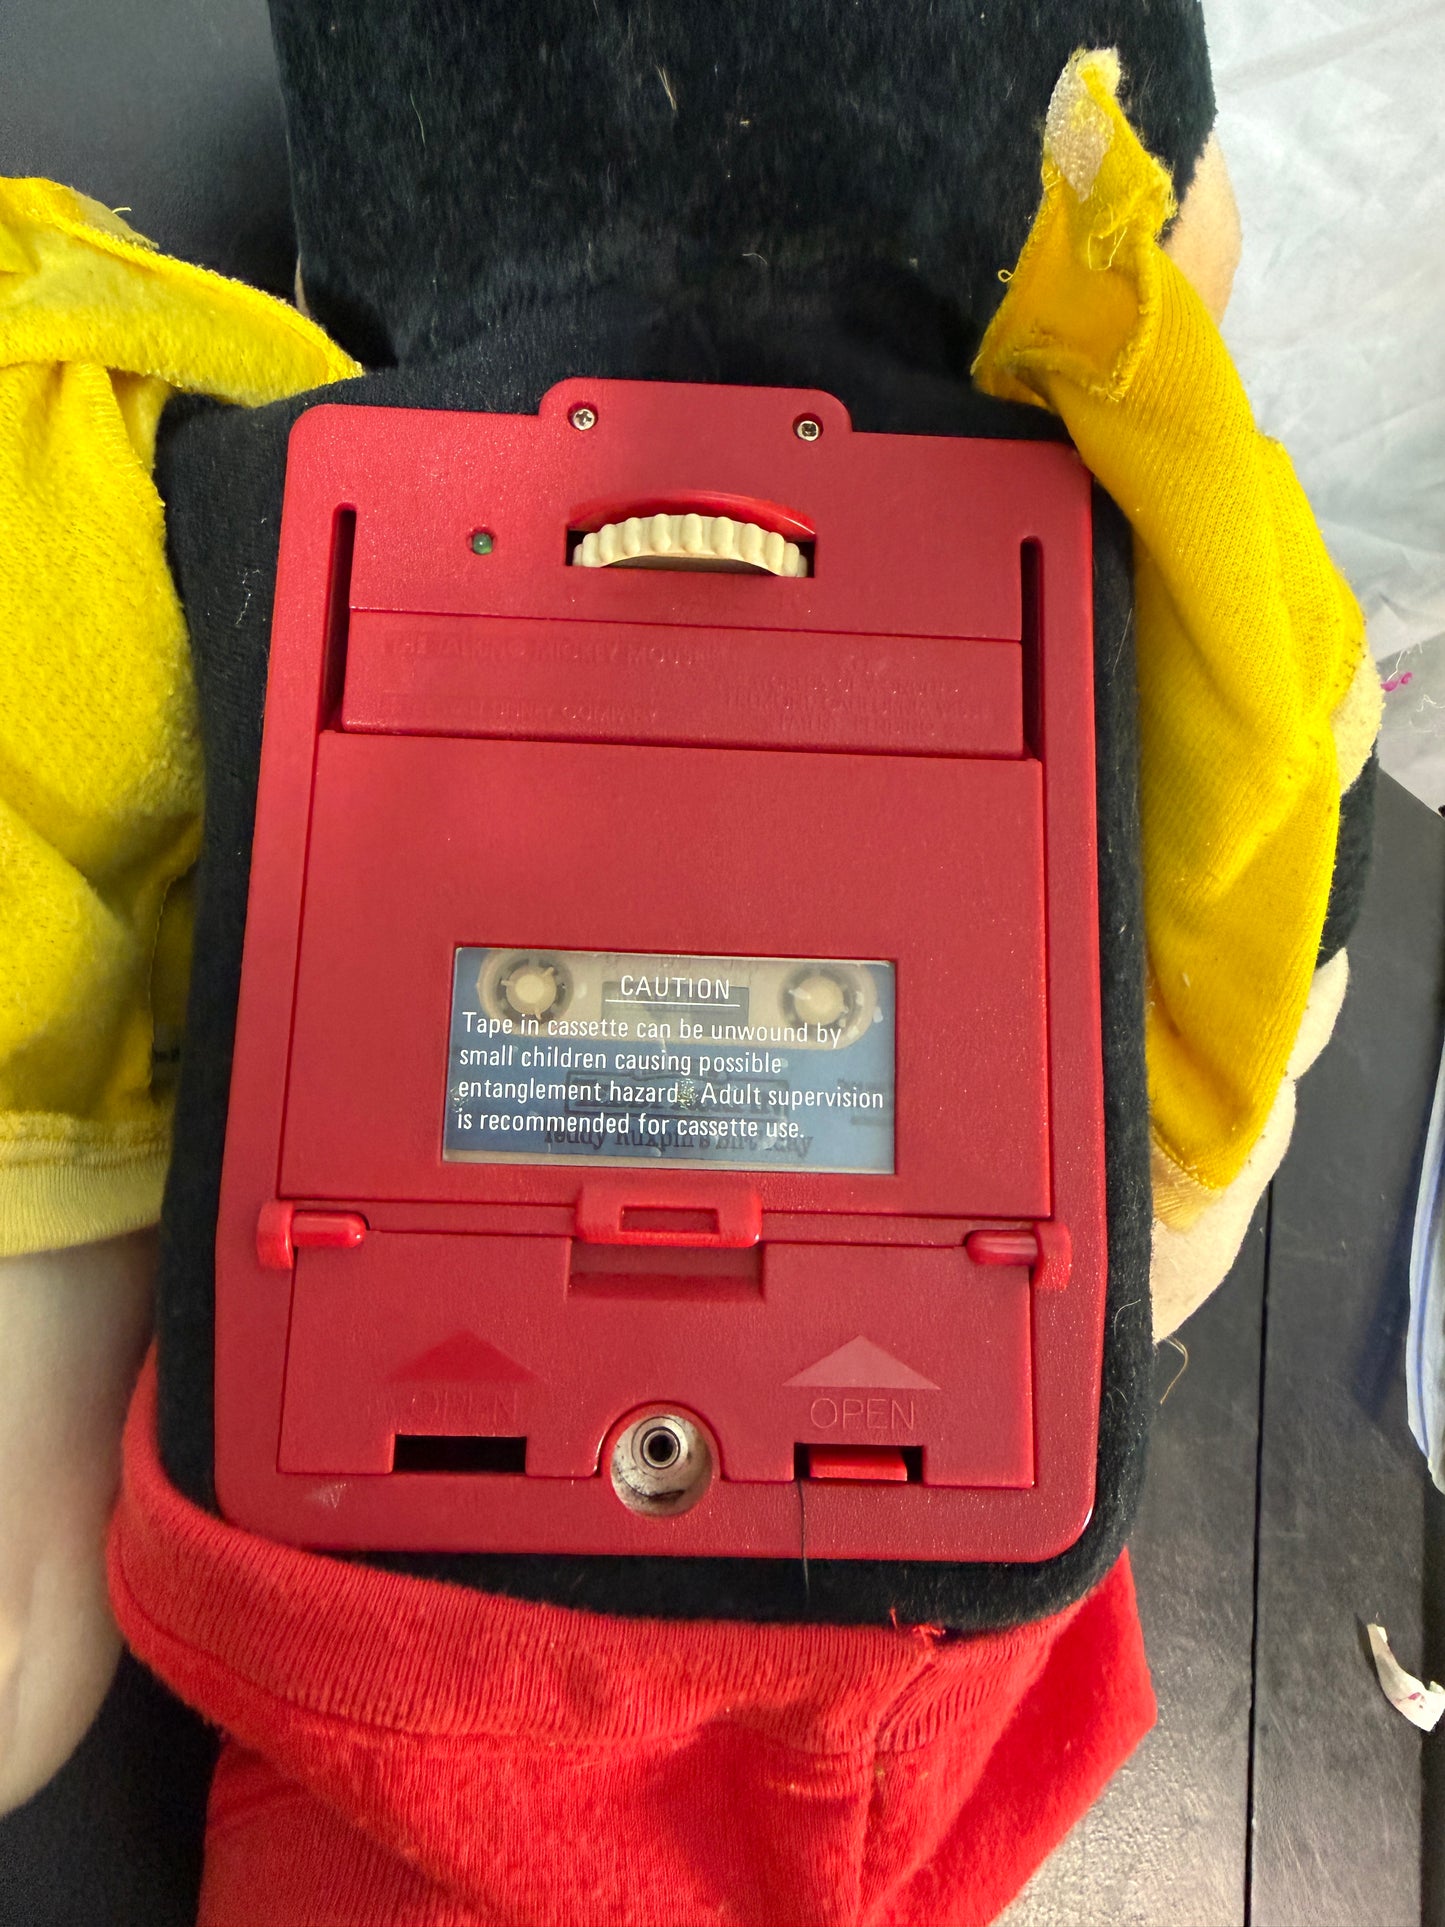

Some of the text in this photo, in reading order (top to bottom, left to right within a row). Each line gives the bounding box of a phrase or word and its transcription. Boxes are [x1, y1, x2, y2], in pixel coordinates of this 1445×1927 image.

[620, 974, 731, 1000] CAUTION
[462, 1011, 841, 1049] Tape in cassette can be unwound by
[459, 1046, 782, 1076] small children causing possible
[458, 1078, 602, 1105] entanglement
[700, 1083, 761, 1106] Adult
[768, 1086, 885, 1110] supervision
[457, 1111, 805, 1139] is recommended for cassette use.
[809, 1396, 916, 1431] OPEN
